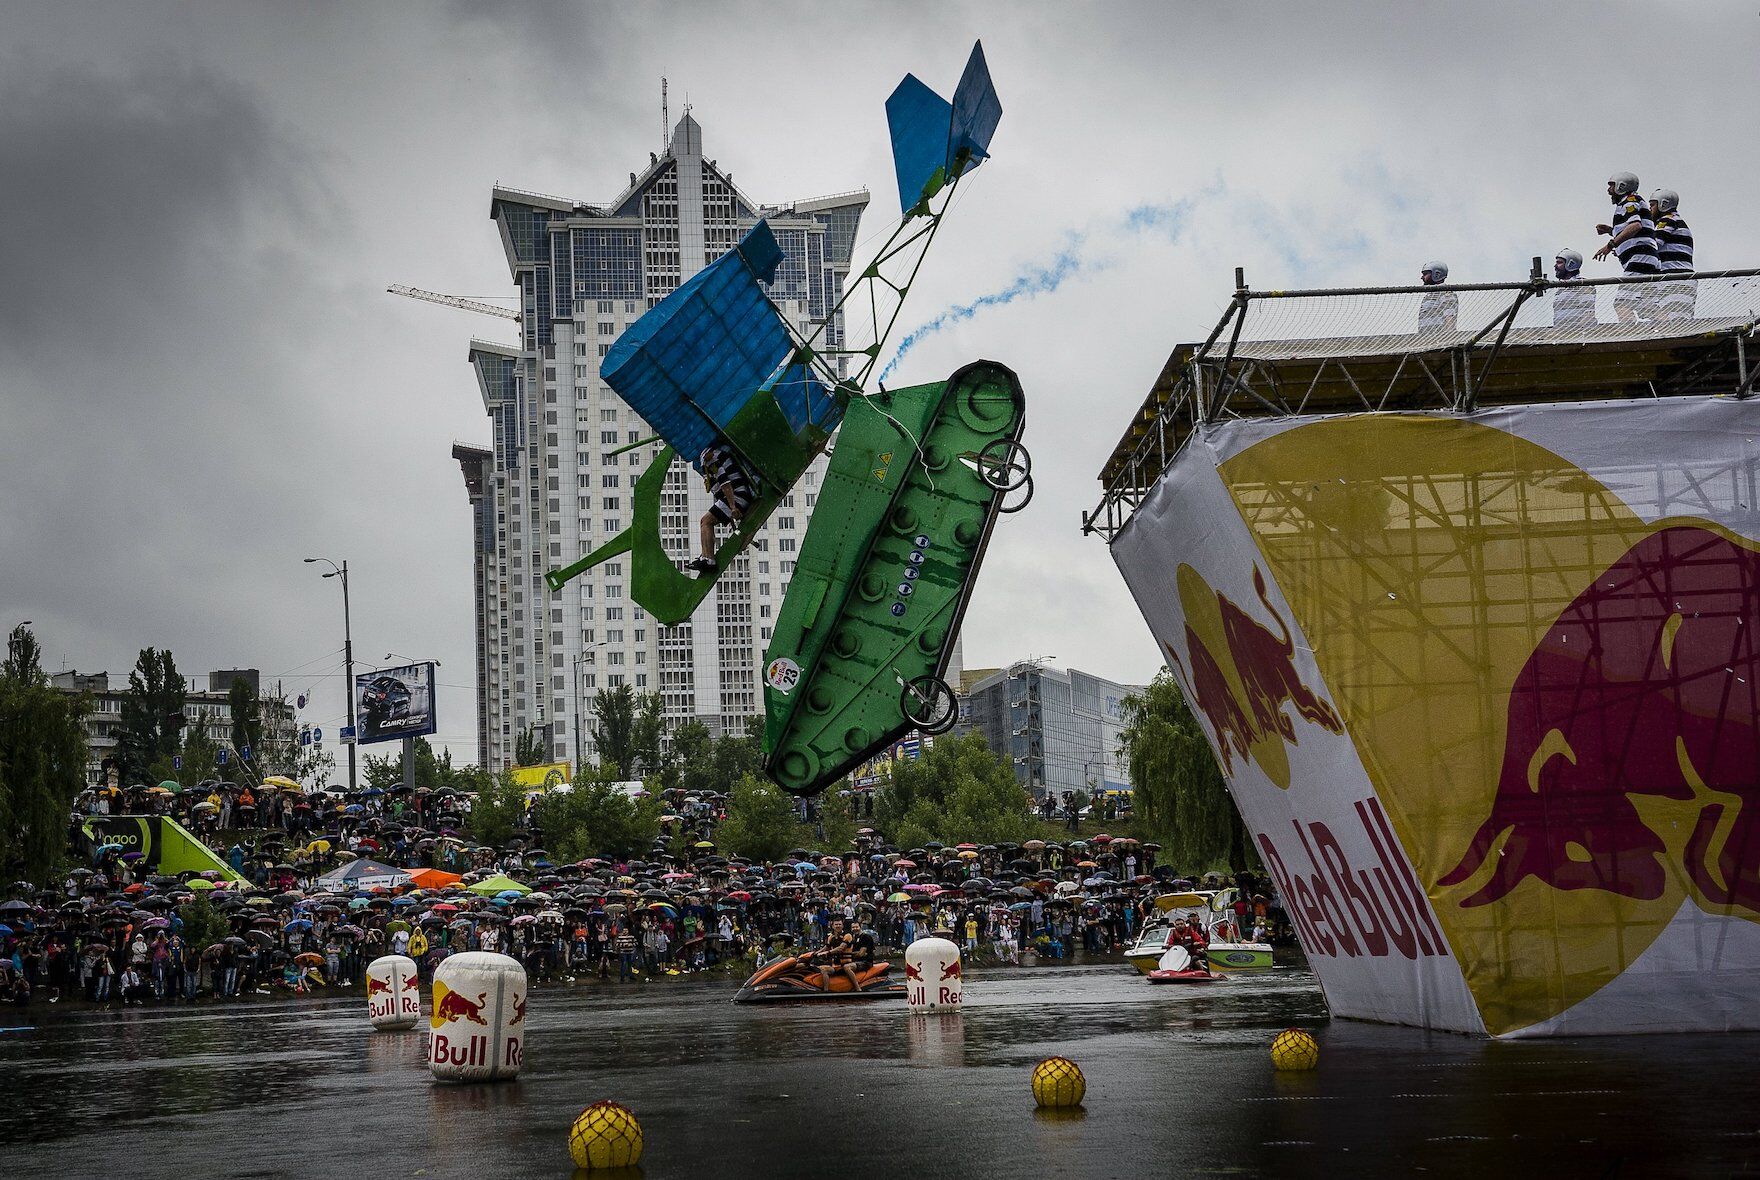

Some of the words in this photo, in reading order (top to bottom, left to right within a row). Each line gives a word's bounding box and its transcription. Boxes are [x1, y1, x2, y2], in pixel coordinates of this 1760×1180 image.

[783, 668, 798, 685] 23
[380, 719, 407, 728] CAMRY
[908, 986, 925, 1005] ull
[370, 997, 395, 1018] Bull
[402, 997, 421, 1013] Re
[434, 1034, 487, 1066] Bull
